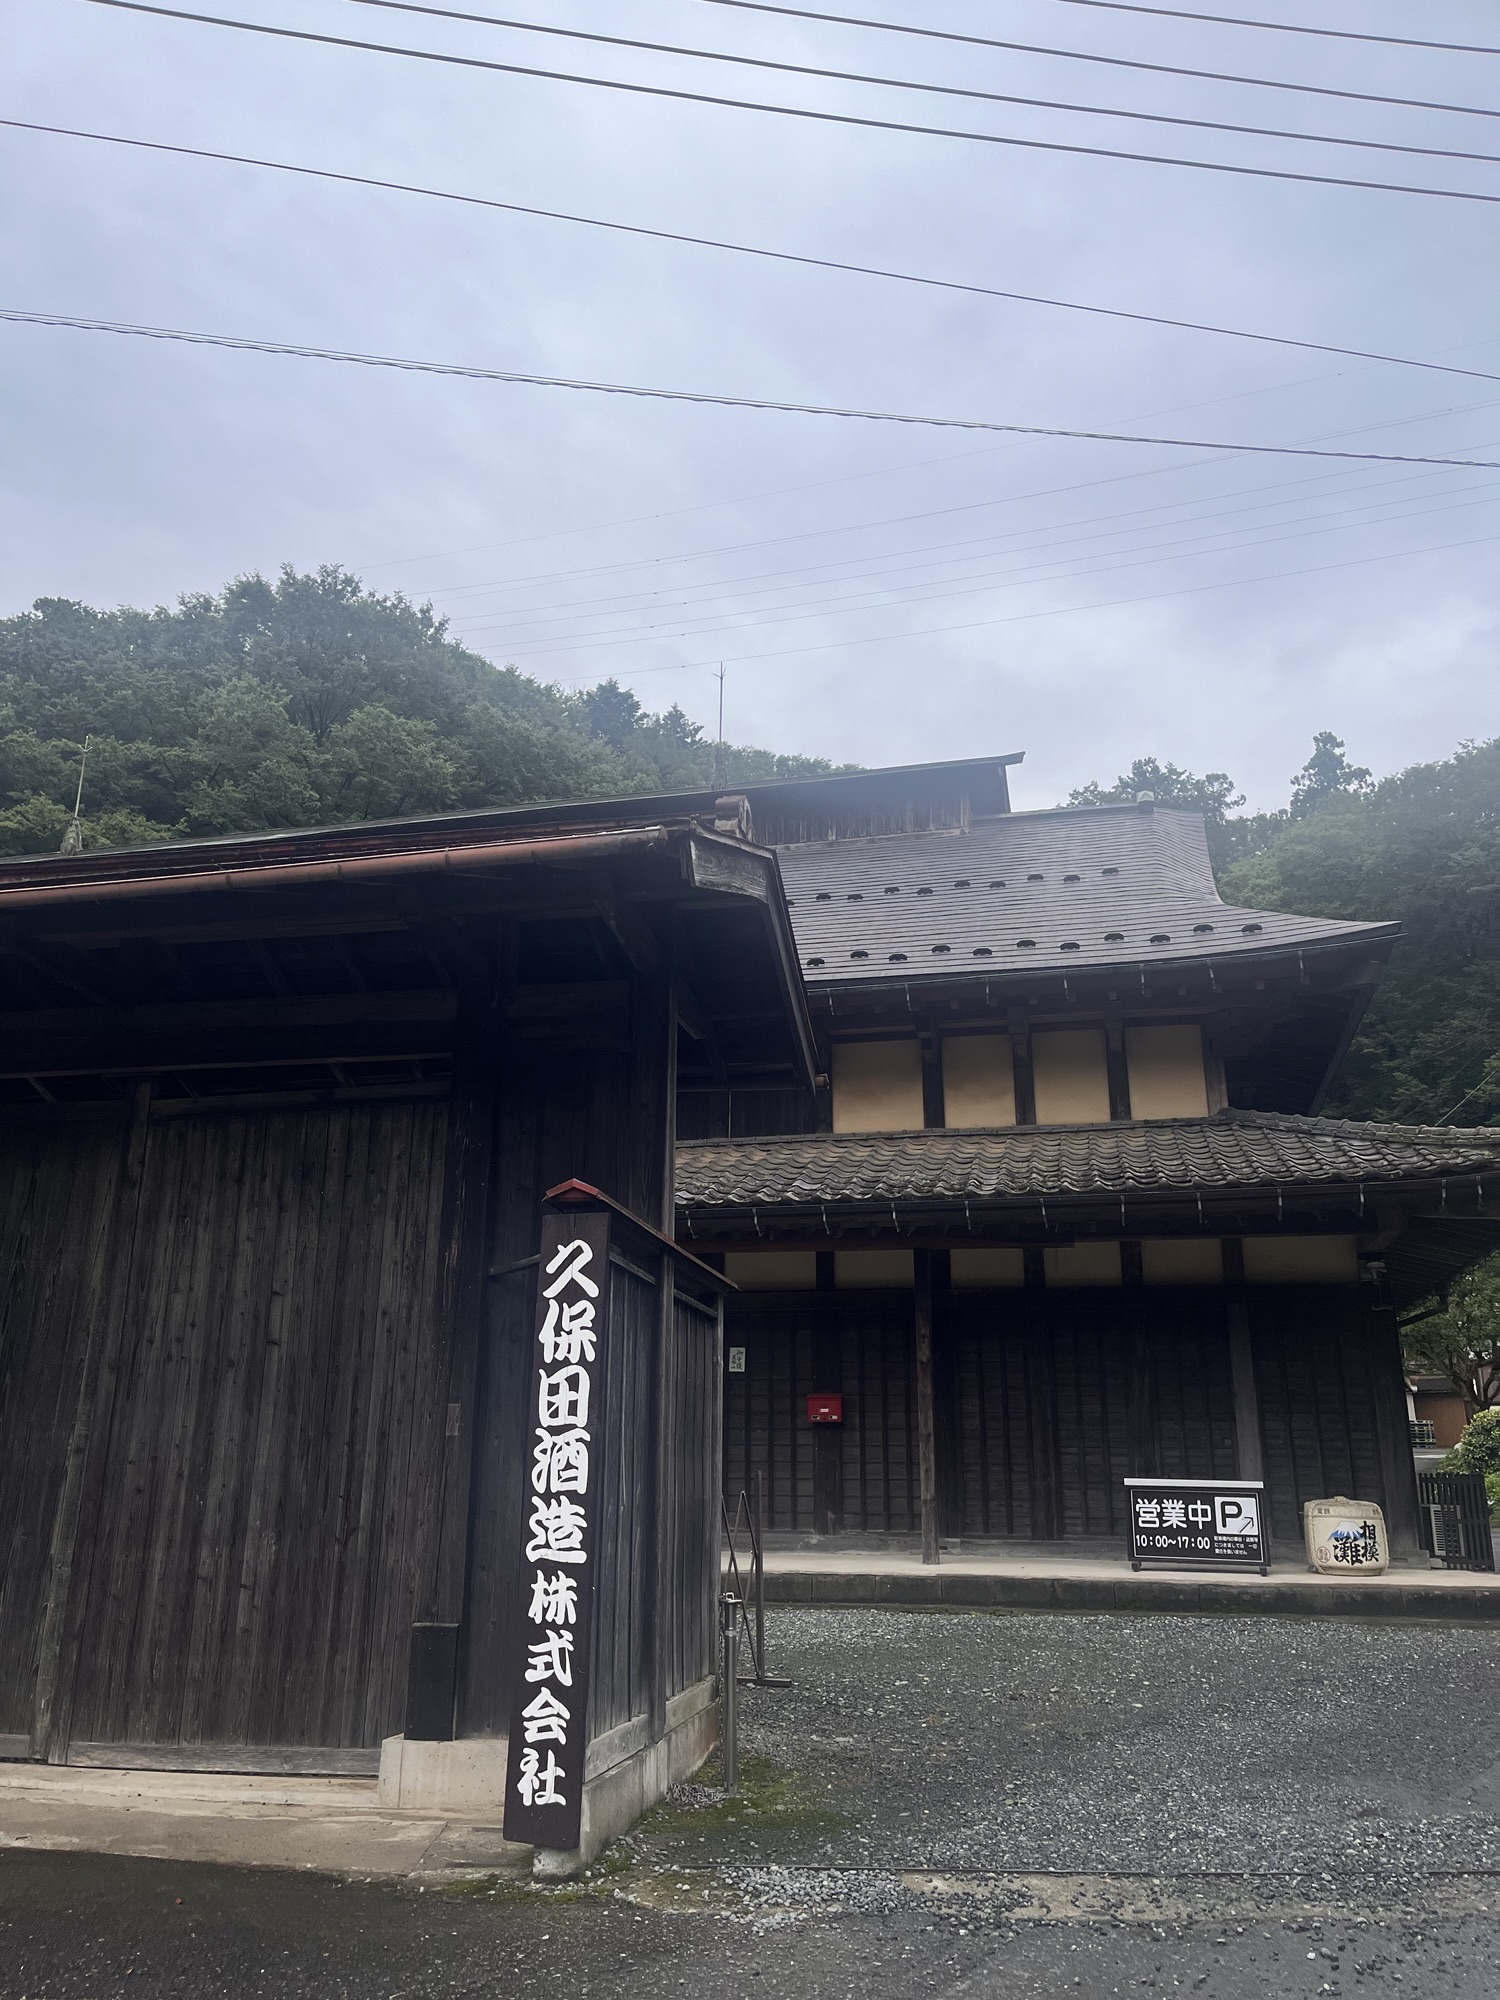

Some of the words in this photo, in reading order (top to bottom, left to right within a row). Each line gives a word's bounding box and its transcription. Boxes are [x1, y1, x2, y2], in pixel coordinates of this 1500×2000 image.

[516, 1239, 599, 1806] 久保田酒造株式会社
[1136, 1499, 1212, 1530] 営業中
[1221, 1501, 1243, 1529] P
